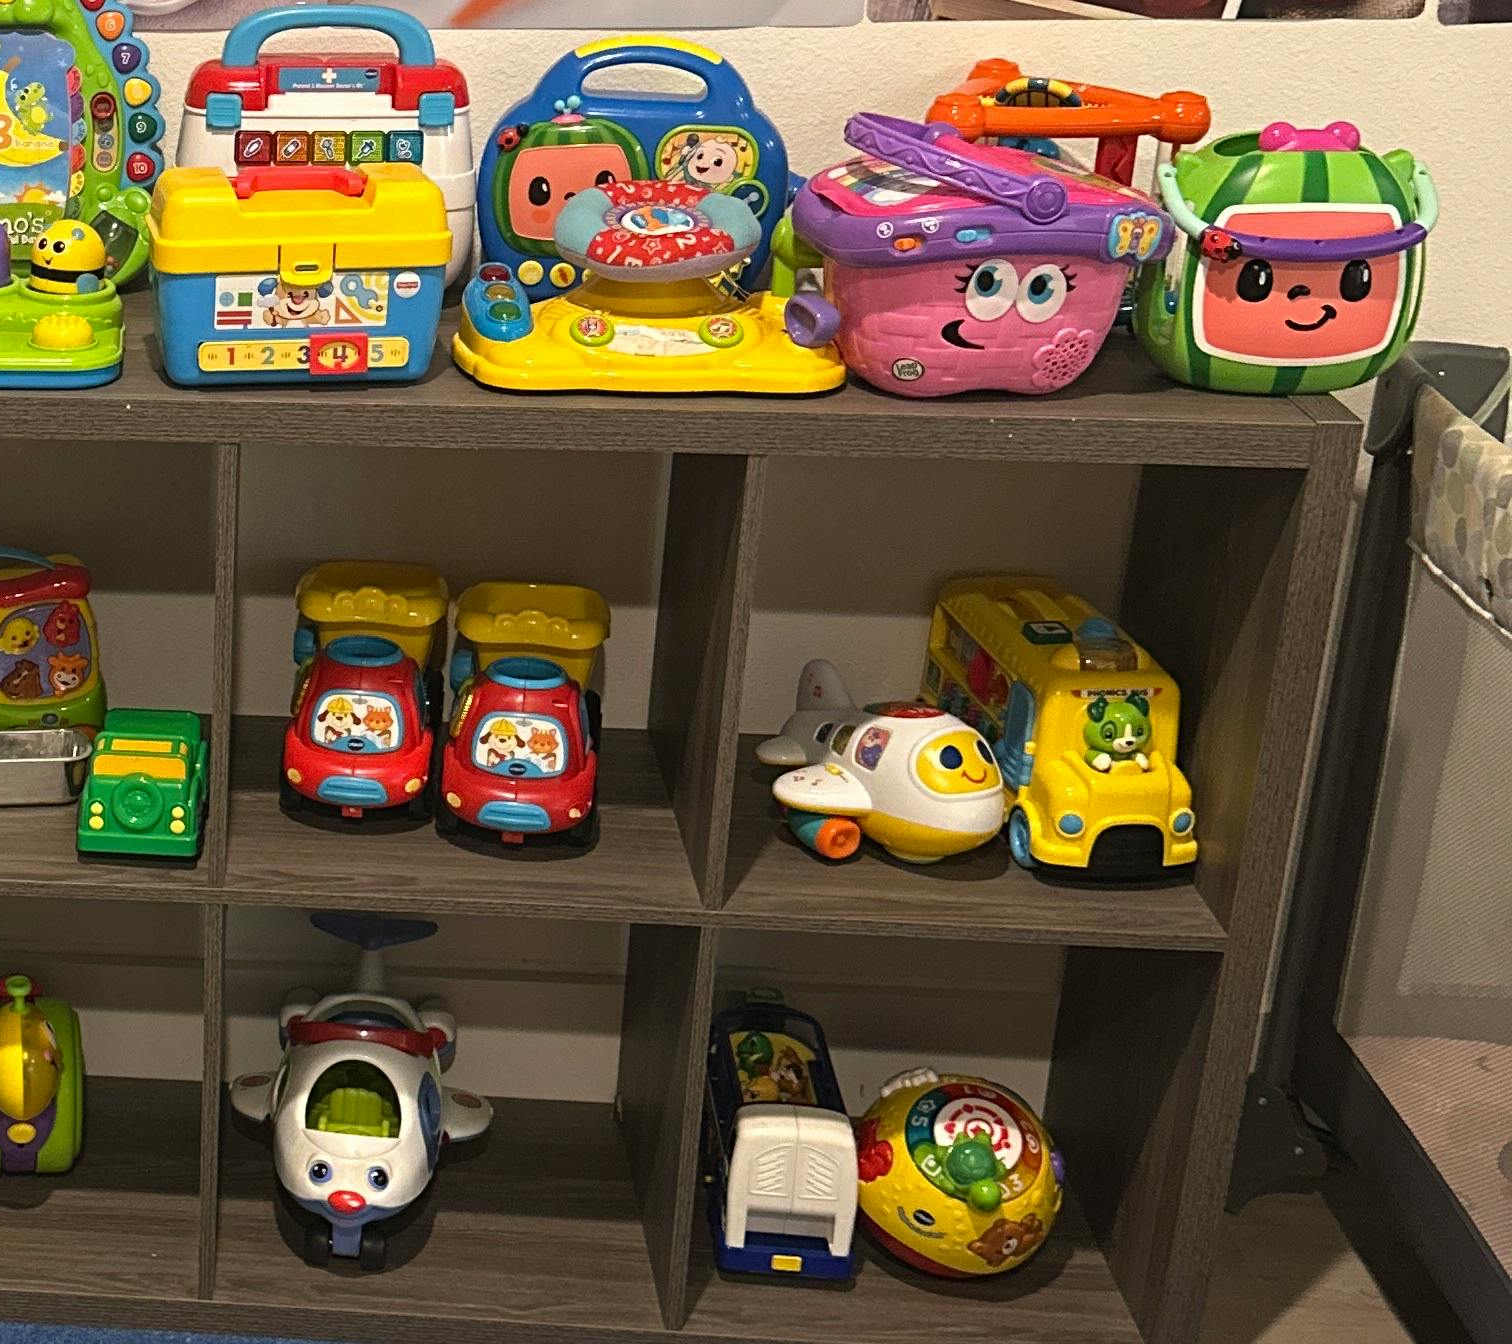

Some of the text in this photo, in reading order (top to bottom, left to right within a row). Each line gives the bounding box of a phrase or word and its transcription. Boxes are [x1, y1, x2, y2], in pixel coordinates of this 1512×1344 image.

[121, 51, 131, 64] 7
[136, 120, 146, 134] 9
[15, 138, 55, 149] banana
[133, 161, 147, 174] 10
[227, 347, 235, 365] 1
[260, 346, 275, 364] 2
[297, 345, 311, 364] 3
[370, 344, 384, 363] 5
